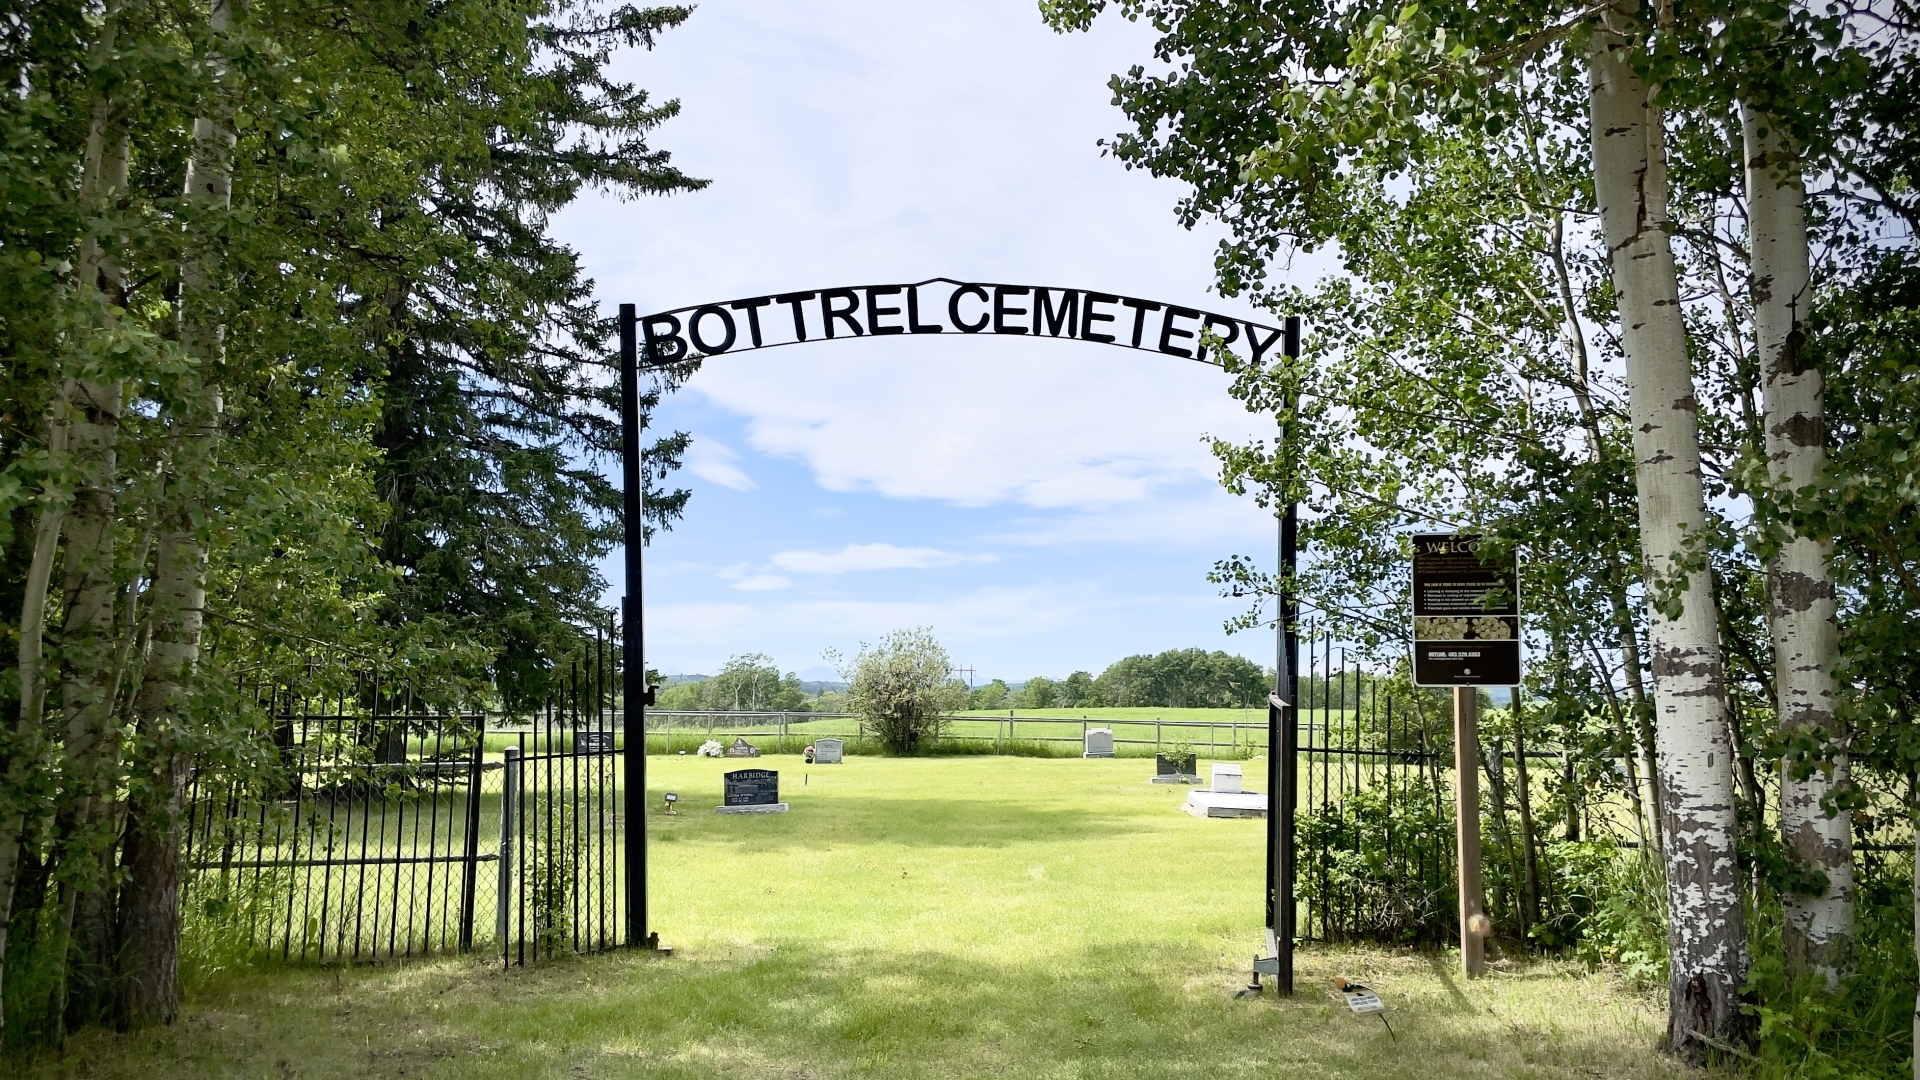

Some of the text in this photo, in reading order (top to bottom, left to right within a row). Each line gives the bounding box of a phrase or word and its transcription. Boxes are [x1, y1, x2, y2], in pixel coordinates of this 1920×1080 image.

[642, 283, 1283, 368] BOTTREL CEMETERY
[1426, 541, 1481, 553] WELCO
[732, 771, 770, 780] HARBIDGE
